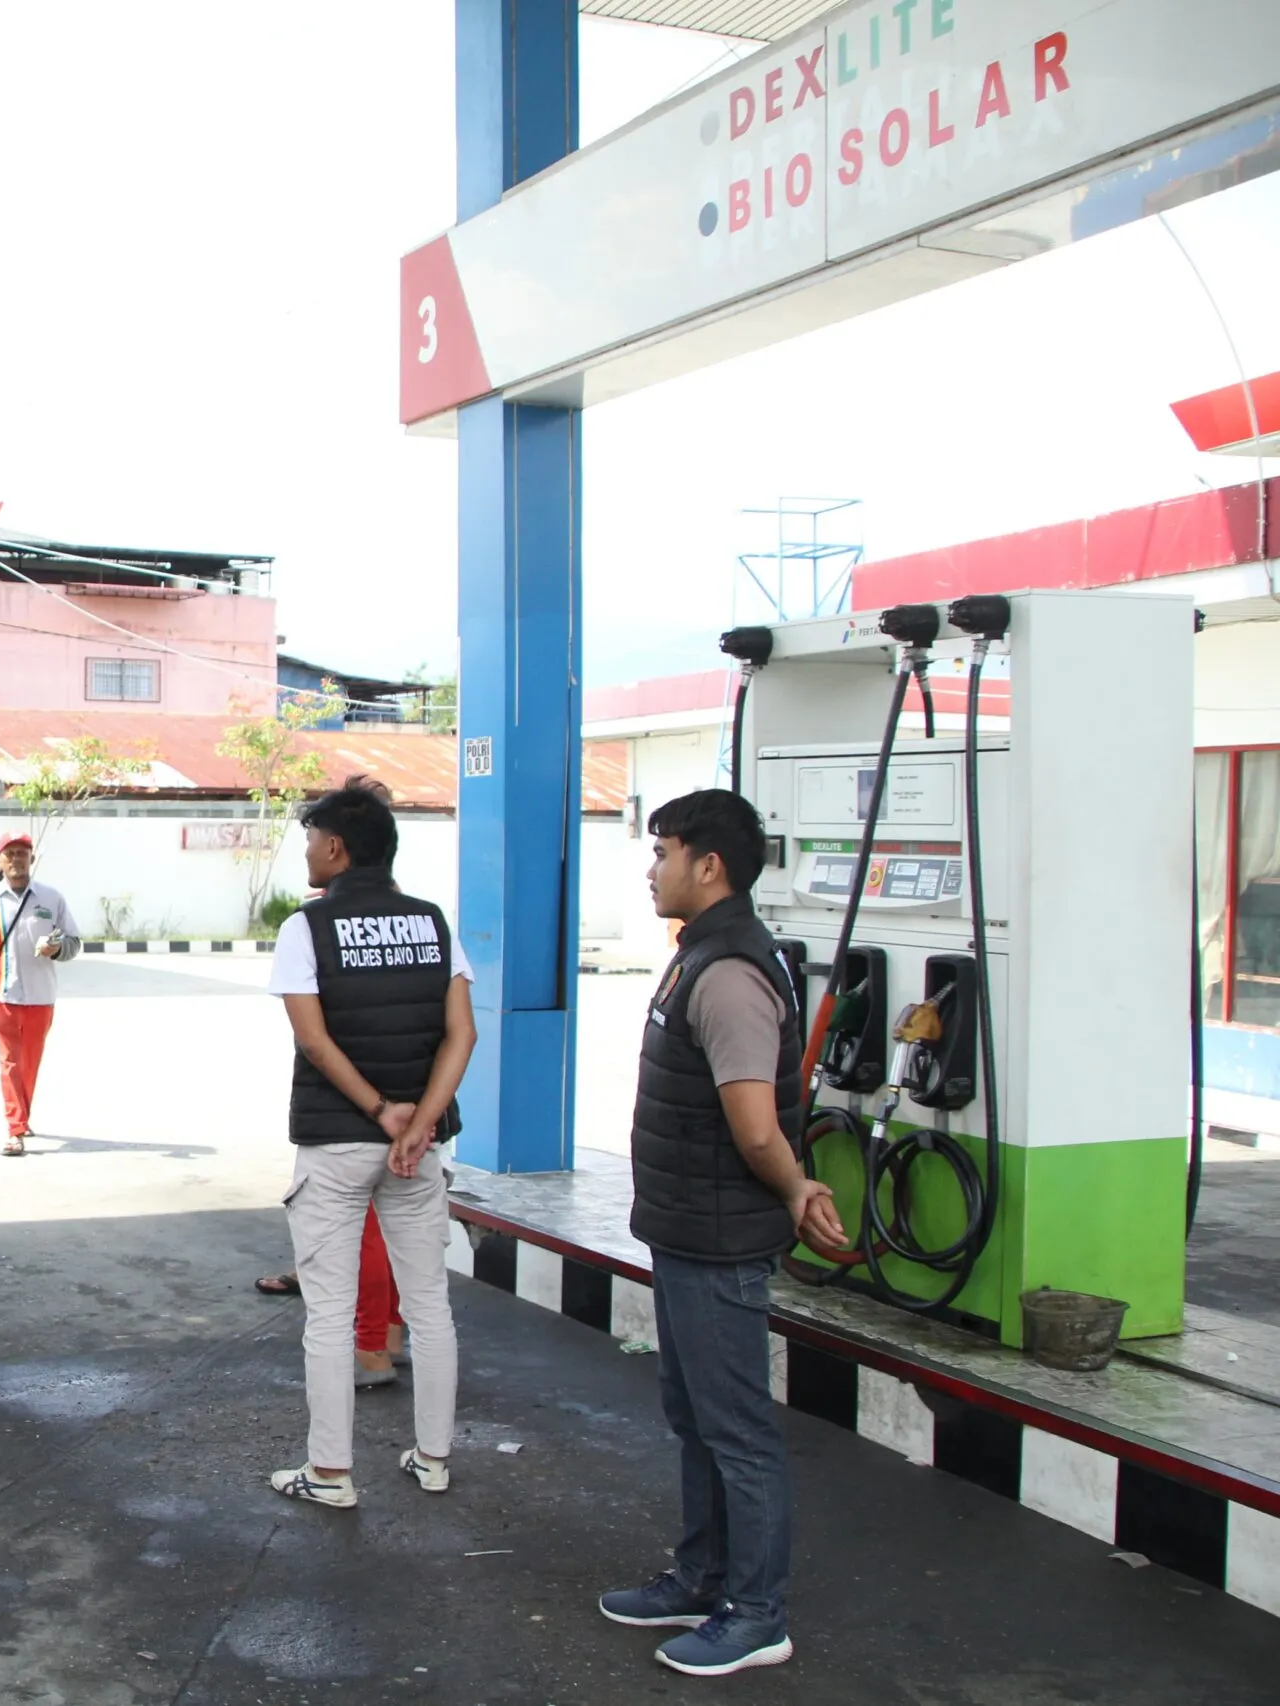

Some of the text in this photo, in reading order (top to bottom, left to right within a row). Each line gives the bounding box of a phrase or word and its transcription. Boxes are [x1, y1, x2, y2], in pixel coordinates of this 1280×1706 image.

[730, 0, 954, 141] DEXLITE
[729, 153, 812, 233] BIO
[838, 31, 1070, 185] SOLAR
[418, 295, 438, 364] 3
[466, 744, 489, 757] POLRI
[812, 842, 842, 852] DEXLITE
[334, 915, 438, 947] RESKRIM
[341, 945, 441, 967] POLRES GAYO LUES
